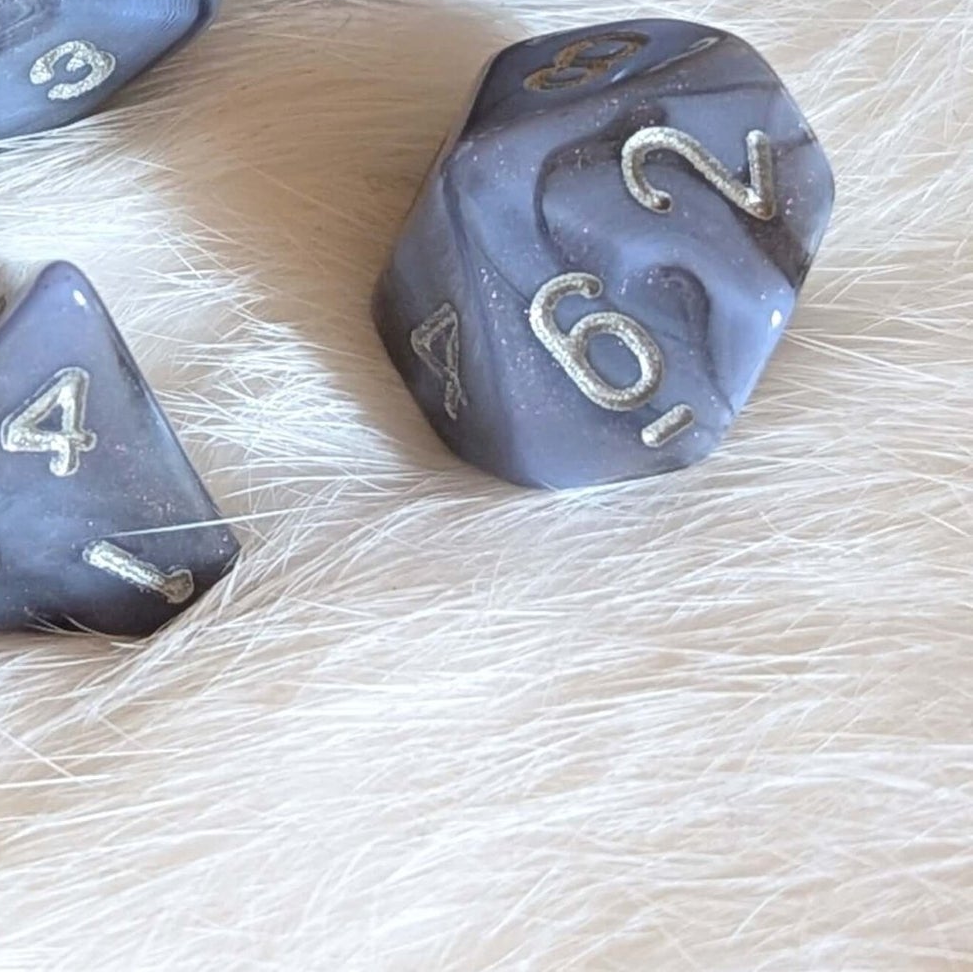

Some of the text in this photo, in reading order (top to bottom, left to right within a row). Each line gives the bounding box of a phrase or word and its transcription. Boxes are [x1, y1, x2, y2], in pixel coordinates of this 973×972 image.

[30, 41, 115, 100] 3
[621, 126, 776, 220] 2
[411, 302, 467, 420] 4
[0, 366, 97, 476] 4
[83, 539, 195, 604] 1
